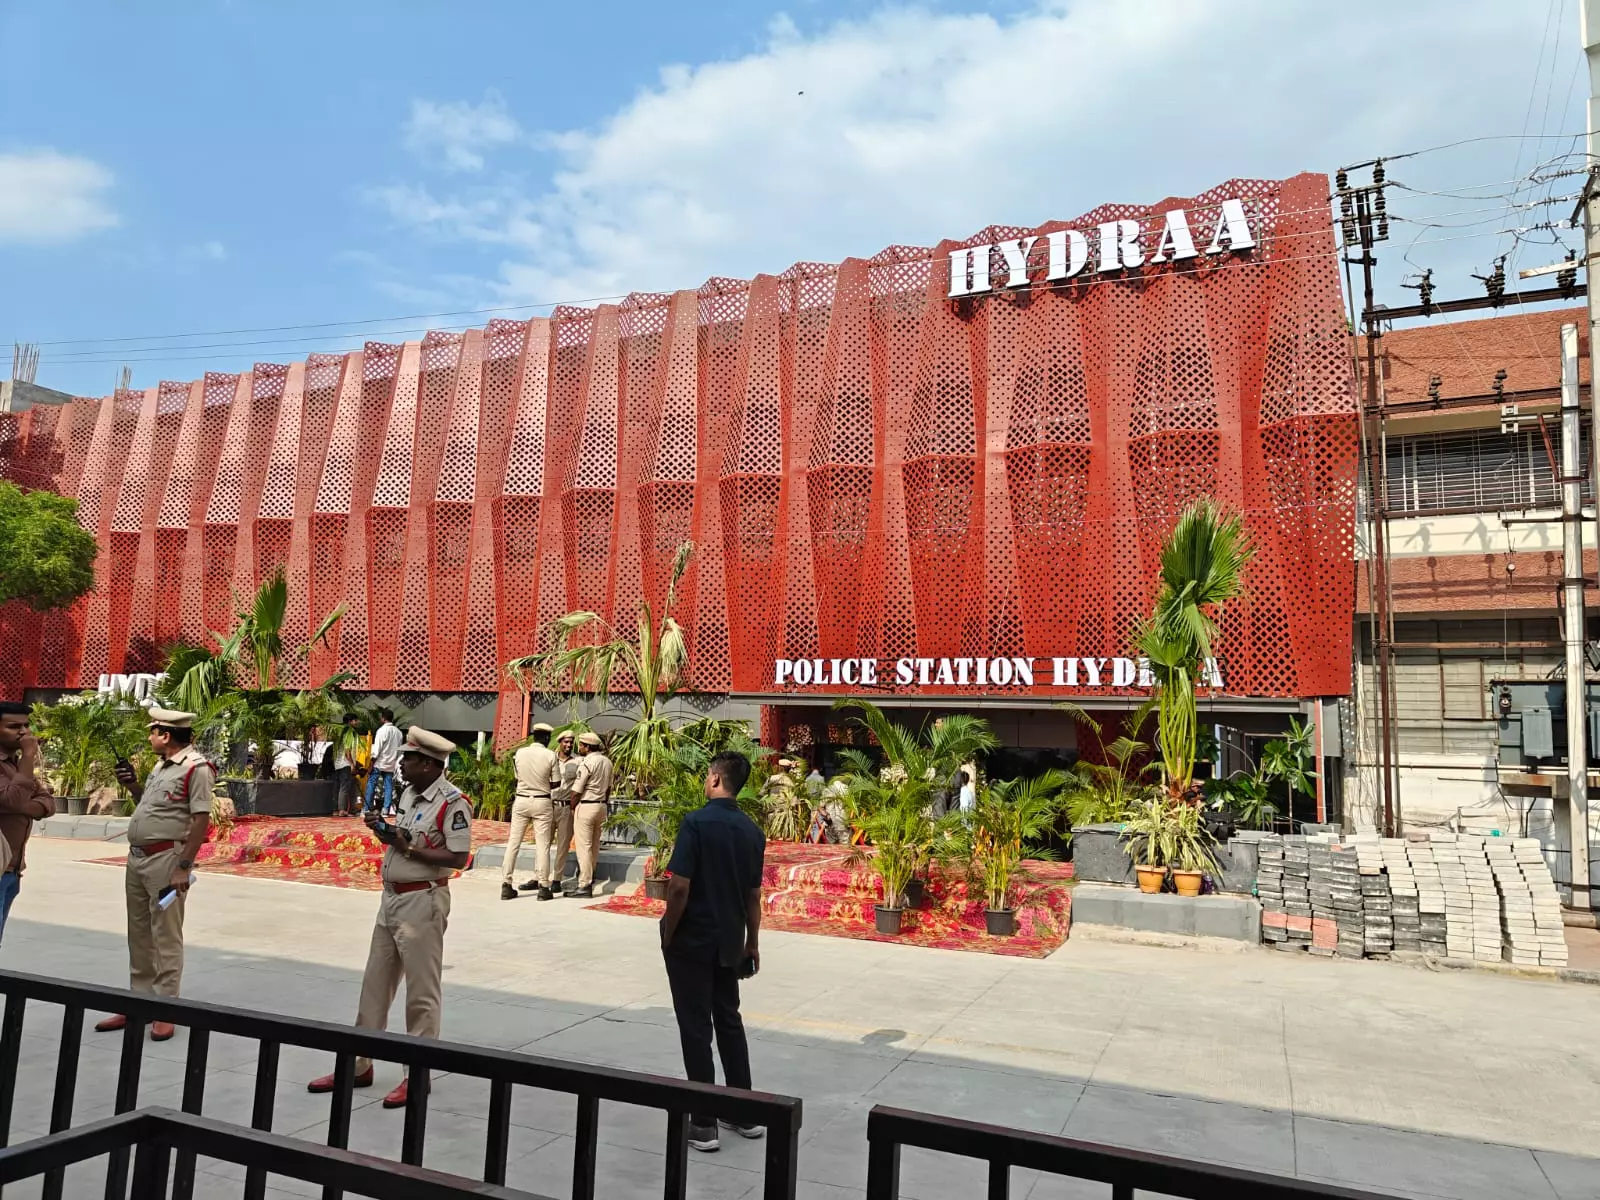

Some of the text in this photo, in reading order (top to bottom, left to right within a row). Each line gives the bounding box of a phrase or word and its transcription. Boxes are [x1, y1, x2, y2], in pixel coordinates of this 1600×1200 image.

[947, 198, 1257, 297] HYDRAA
[775, 657, 1225, 687] POLICE STATION HYDA
